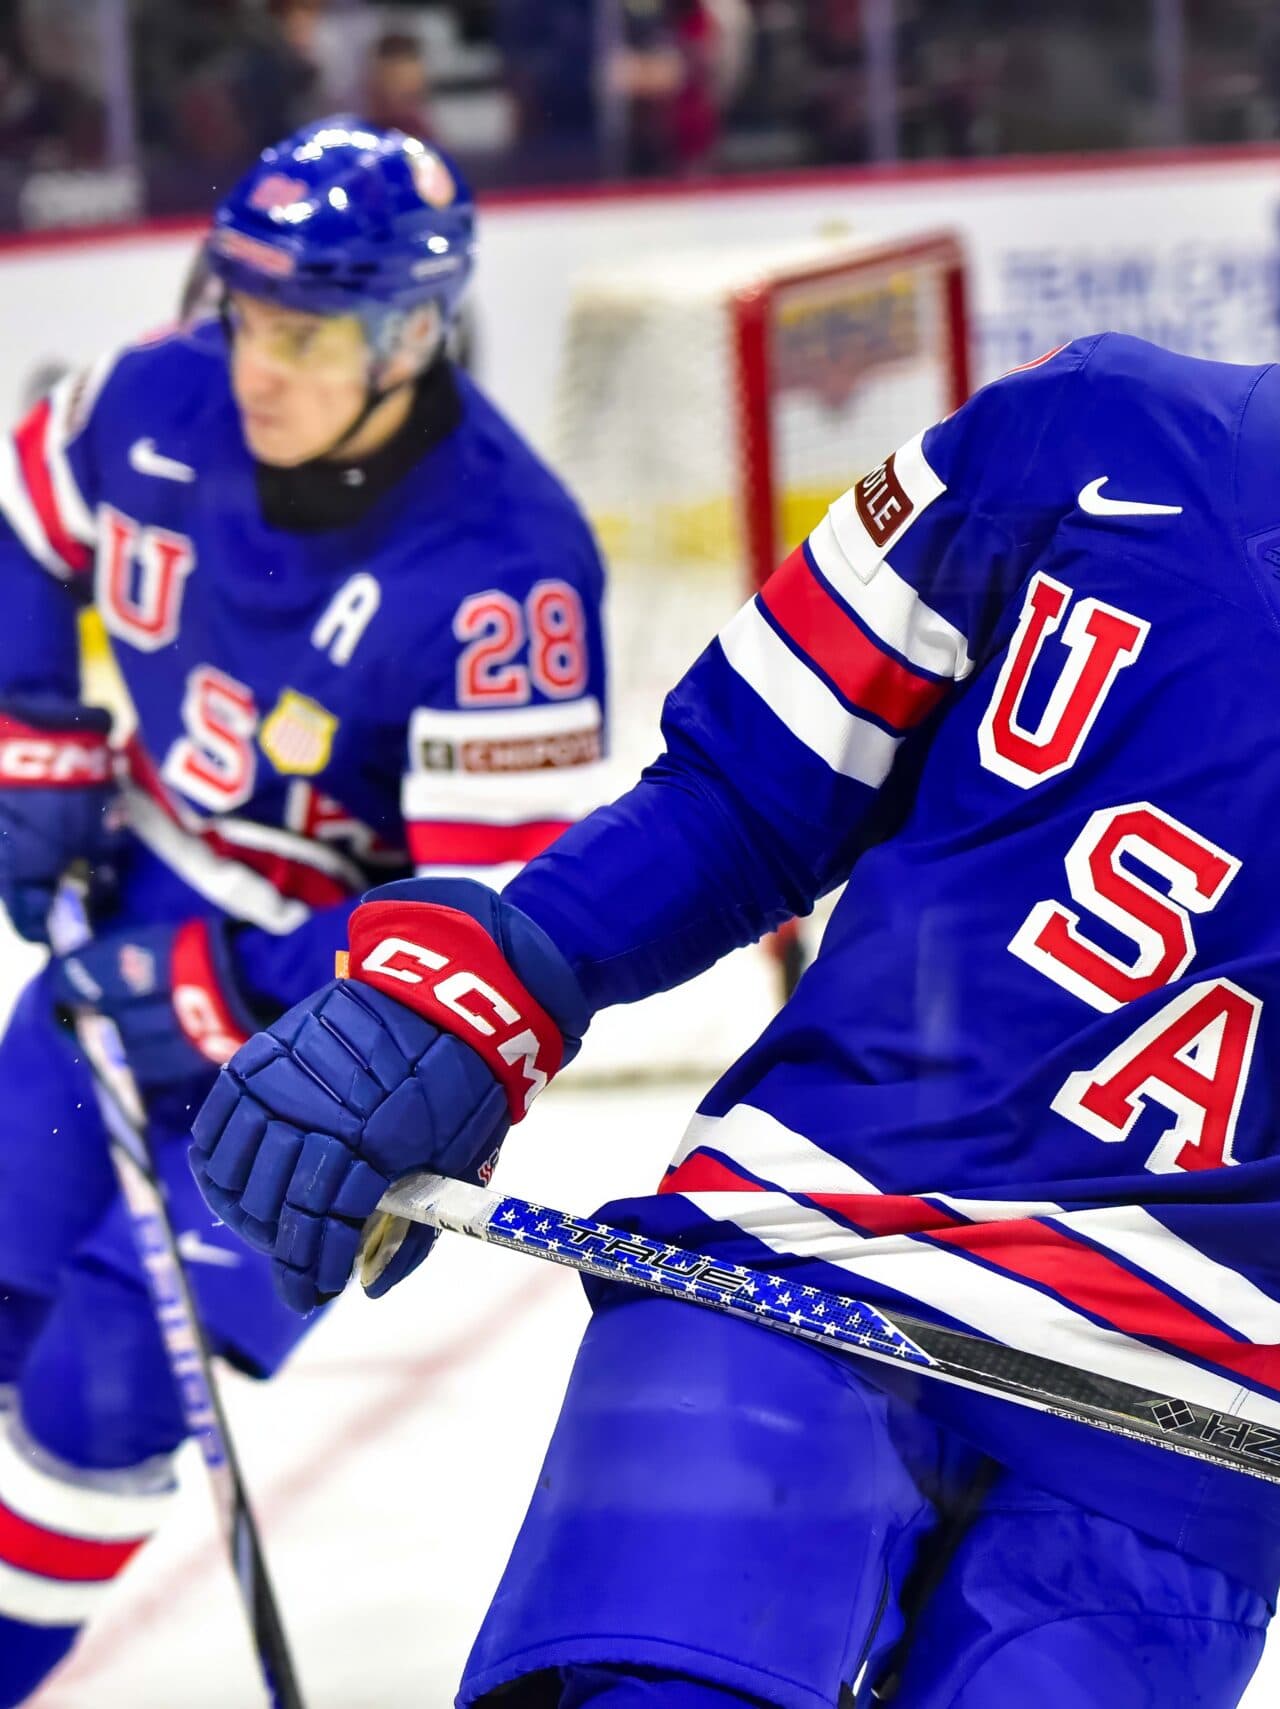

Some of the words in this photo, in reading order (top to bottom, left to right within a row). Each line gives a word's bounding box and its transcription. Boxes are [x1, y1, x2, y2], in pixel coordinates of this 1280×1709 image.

[311, 572, 381, 666] A
[454, 578, 590, 706] 28
[361, 937, 548, 1112] CCM
[561, 1222, 752, 1293] TRUE
